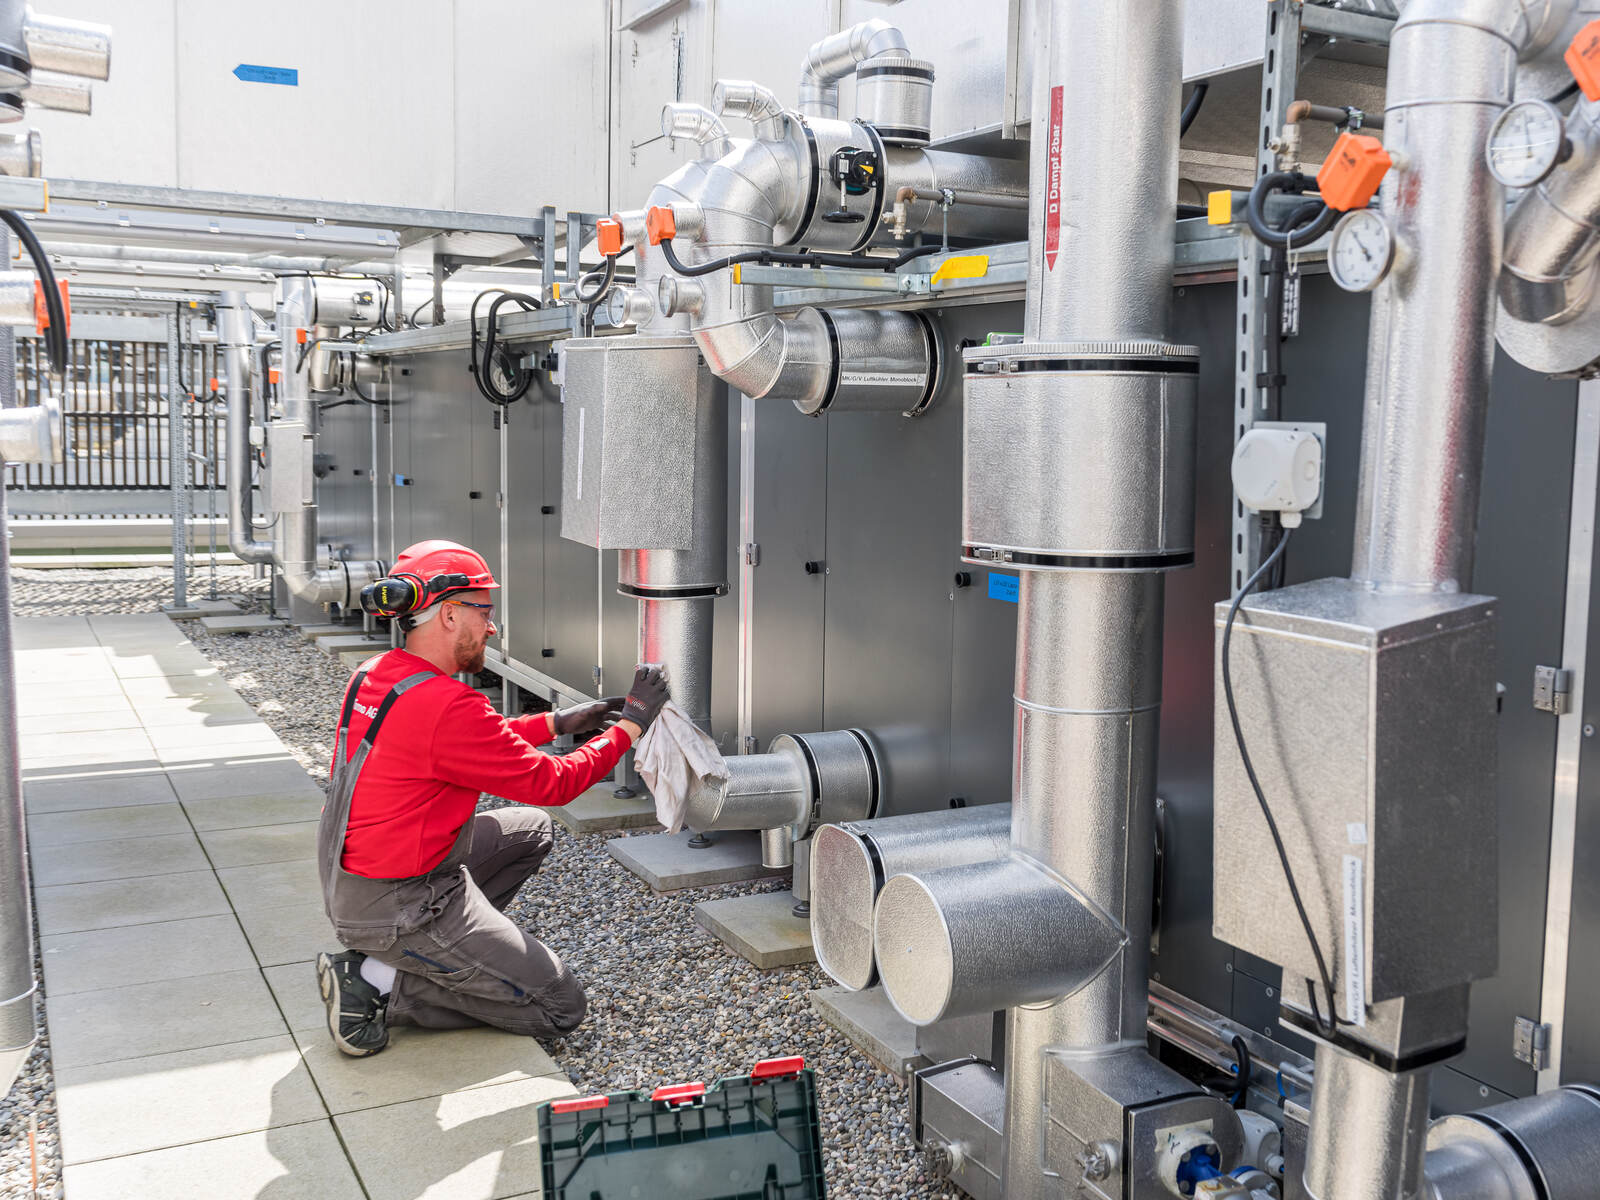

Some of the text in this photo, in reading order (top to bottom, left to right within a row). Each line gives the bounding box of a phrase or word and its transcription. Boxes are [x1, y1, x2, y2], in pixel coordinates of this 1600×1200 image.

[1050, 125, 1061, 213] D Dampf 2bar
[381, 586, 389, 605] uvex
[364, 705, 378, 717] AG
